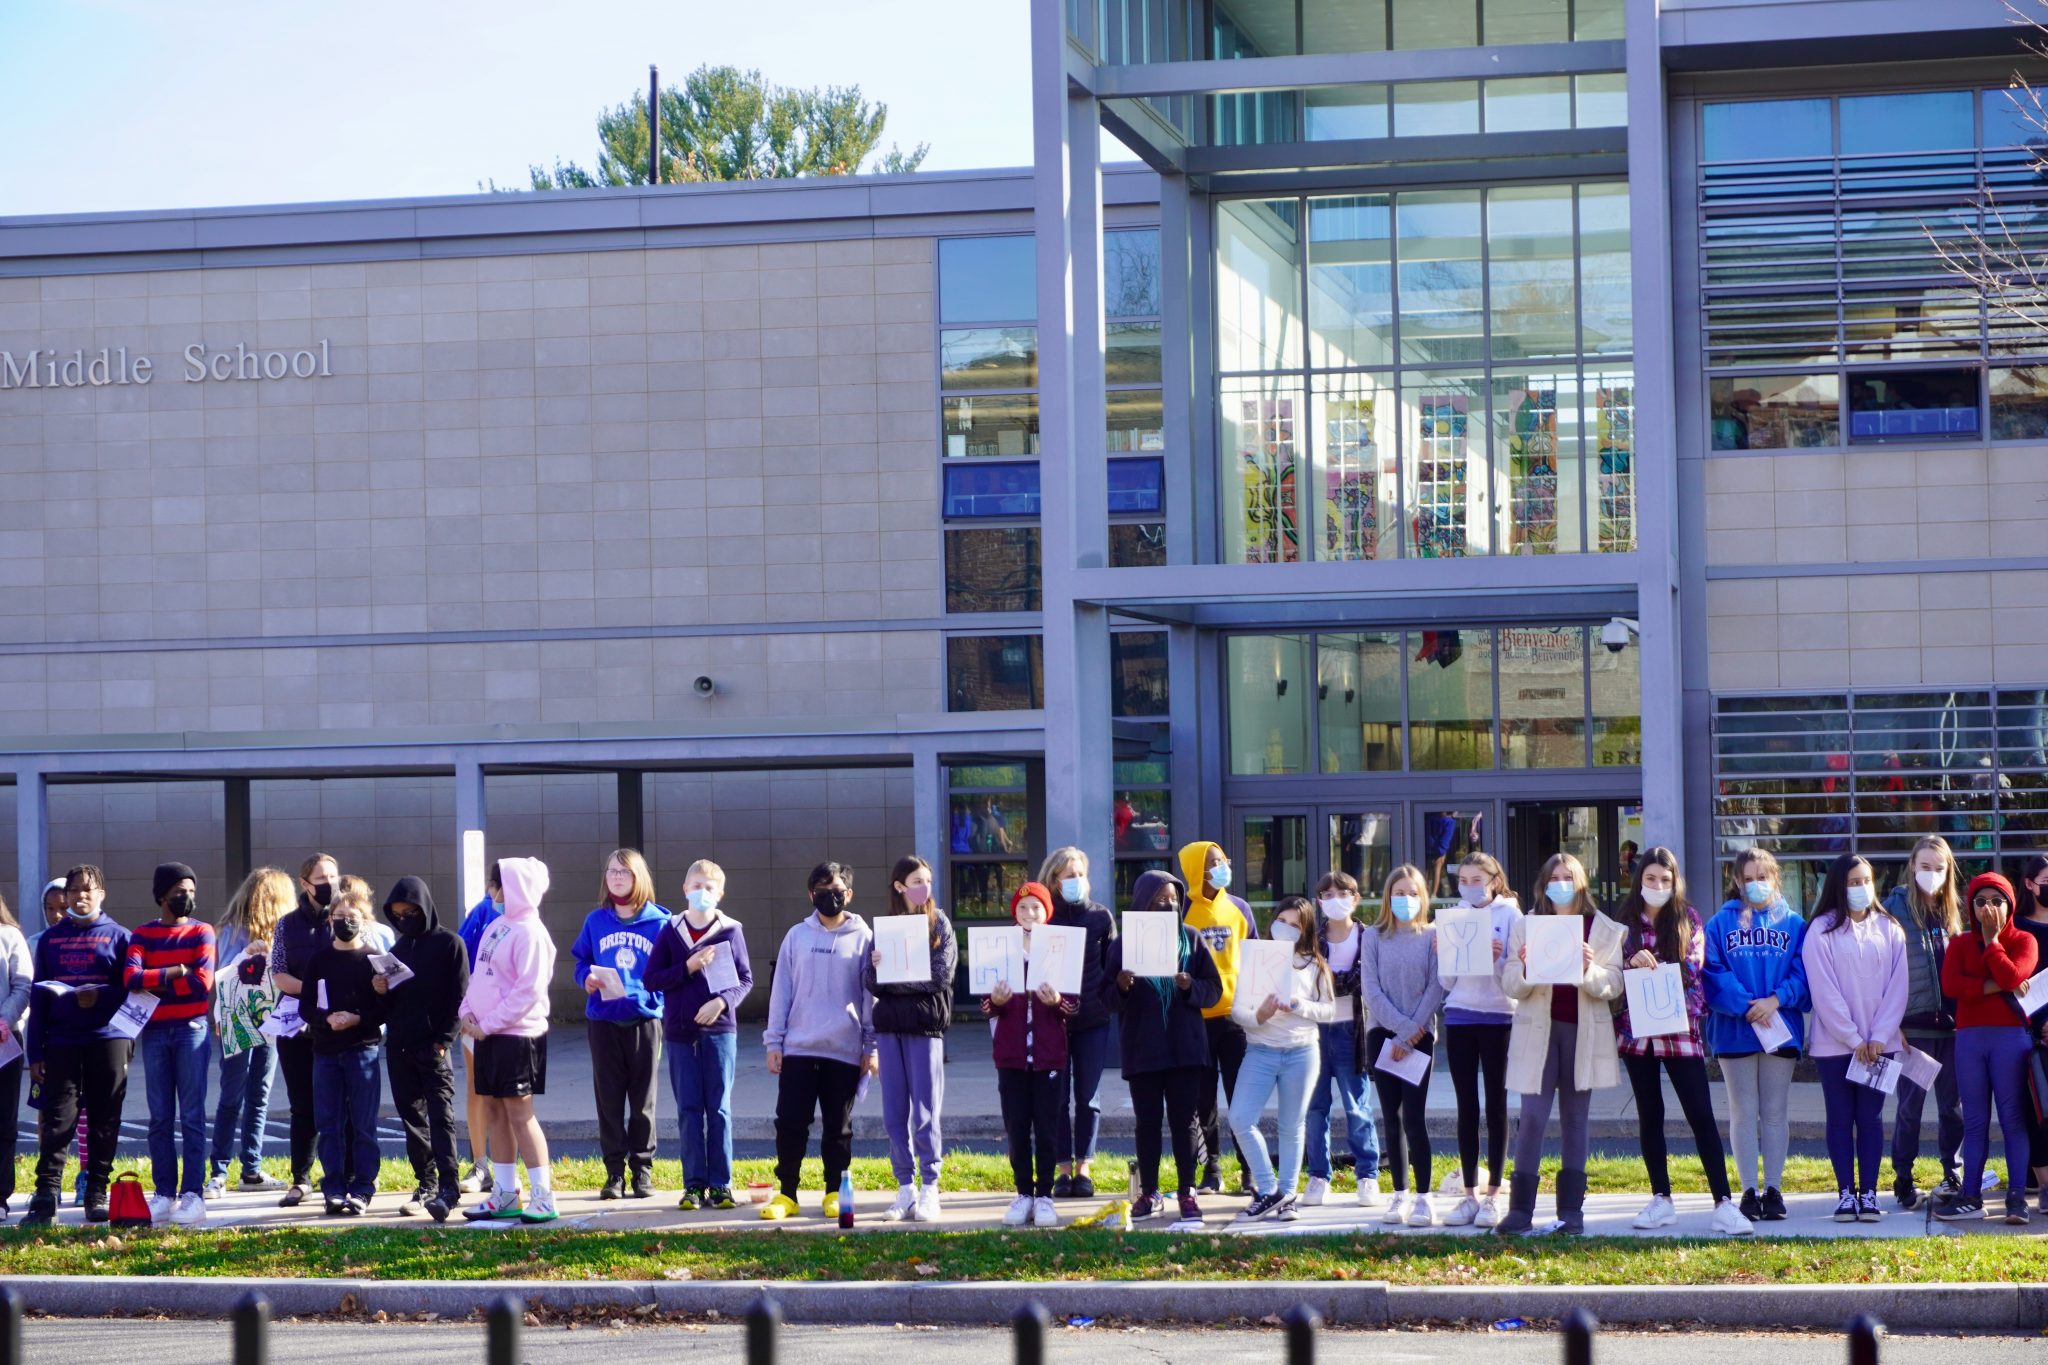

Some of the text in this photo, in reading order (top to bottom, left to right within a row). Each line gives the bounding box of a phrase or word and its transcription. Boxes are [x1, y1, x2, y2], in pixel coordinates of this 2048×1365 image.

[1, 337, 332, 389] Middle School
[1502, 627, 1570, 651] Bienvenue
[599, 931, 654, 956] BRISTOW
[1443, 921, 1478, 973] Y
[1726, 926, 1791, 952] EMORY
[1642, 972, 1680, 1020] U
